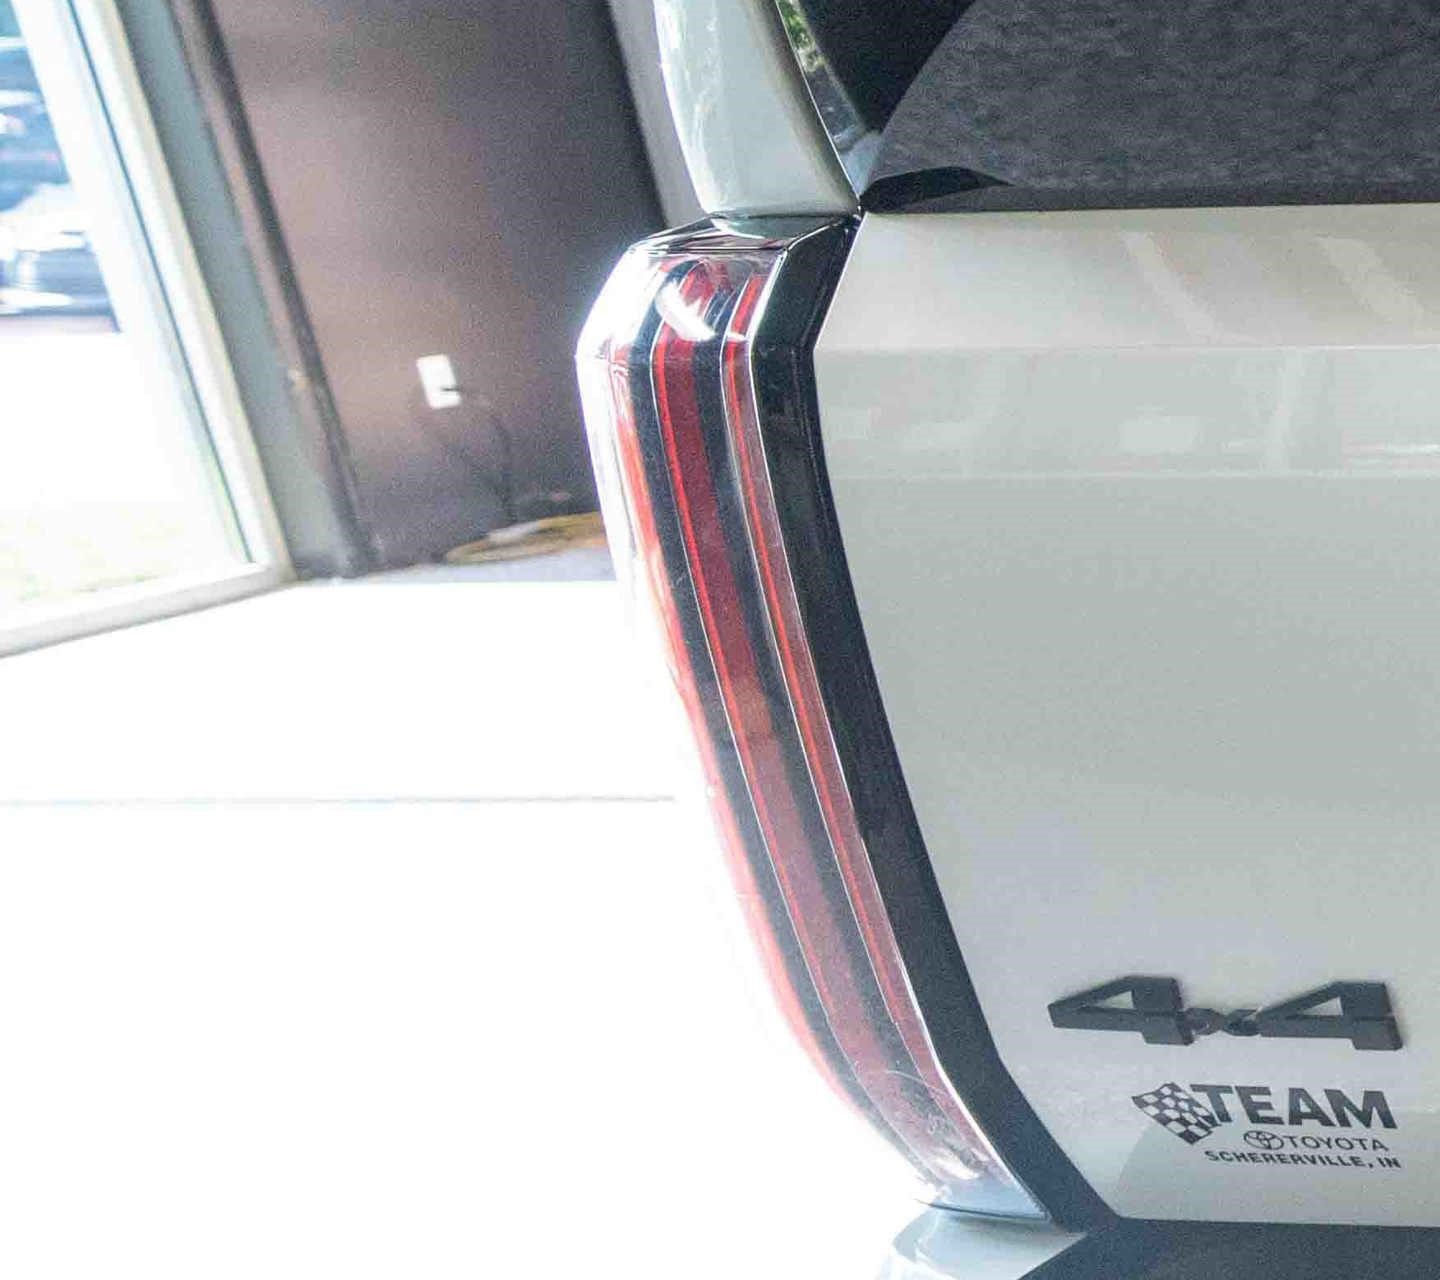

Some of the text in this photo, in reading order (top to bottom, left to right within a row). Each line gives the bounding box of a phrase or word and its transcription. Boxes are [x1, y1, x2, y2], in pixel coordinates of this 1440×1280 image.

[1190, 1083, 1398, 1130] TEAM
[1283, 1135, 1390, 1152] TOYOTA
[1205, 1149, 1402, 1170] SCHERERVILLE, IN
